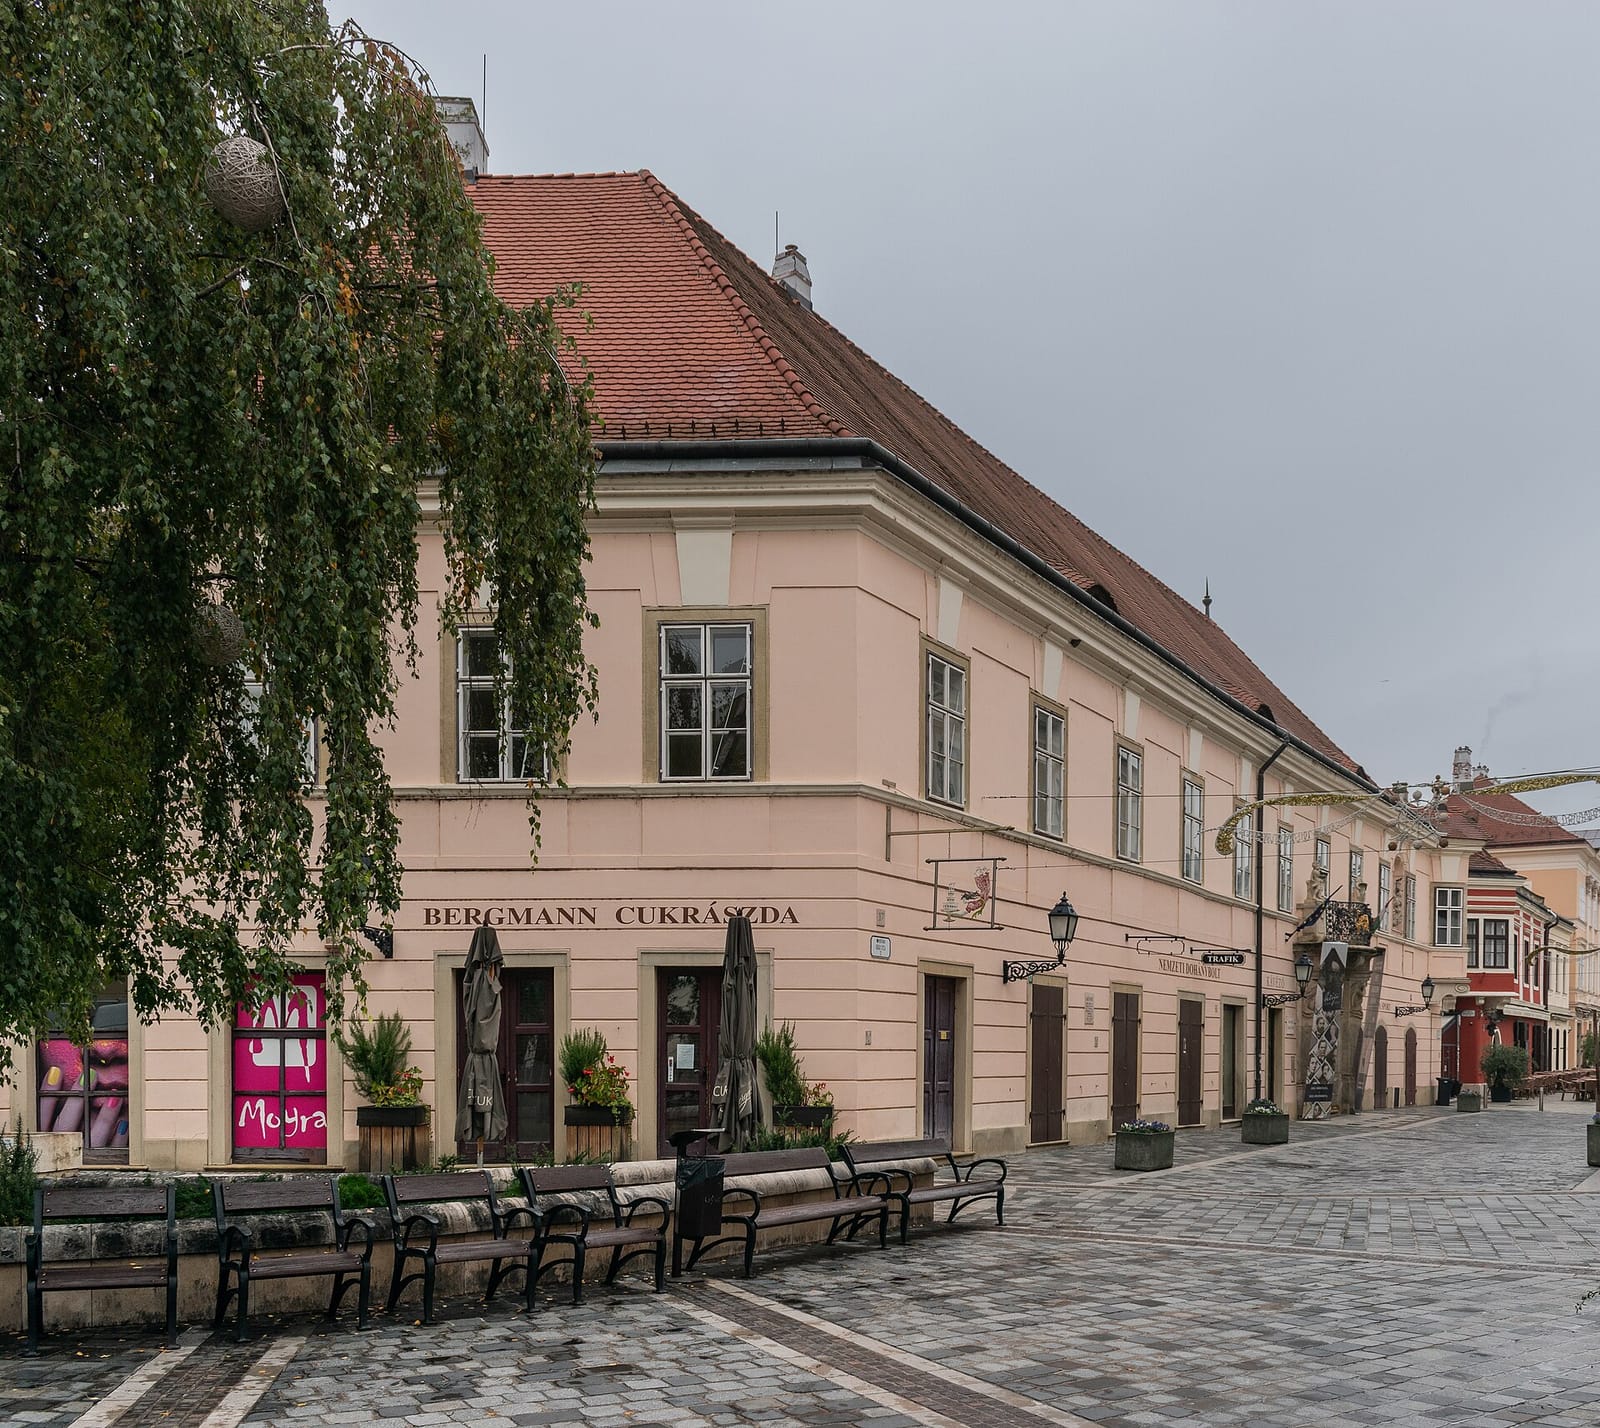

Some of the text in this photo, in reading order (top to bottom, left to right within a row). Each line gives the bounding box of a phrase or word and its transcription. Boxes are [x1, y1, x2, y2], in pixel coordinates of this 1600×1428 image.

[423, 901, 800, 925] BERGMANN CUKRÁSZDA
[1159, 958, 1185, 974] NEMZETI
[1207, 955, 1239, 963] TRAFIK
[239, 1098, 329, 1140] Moyra
